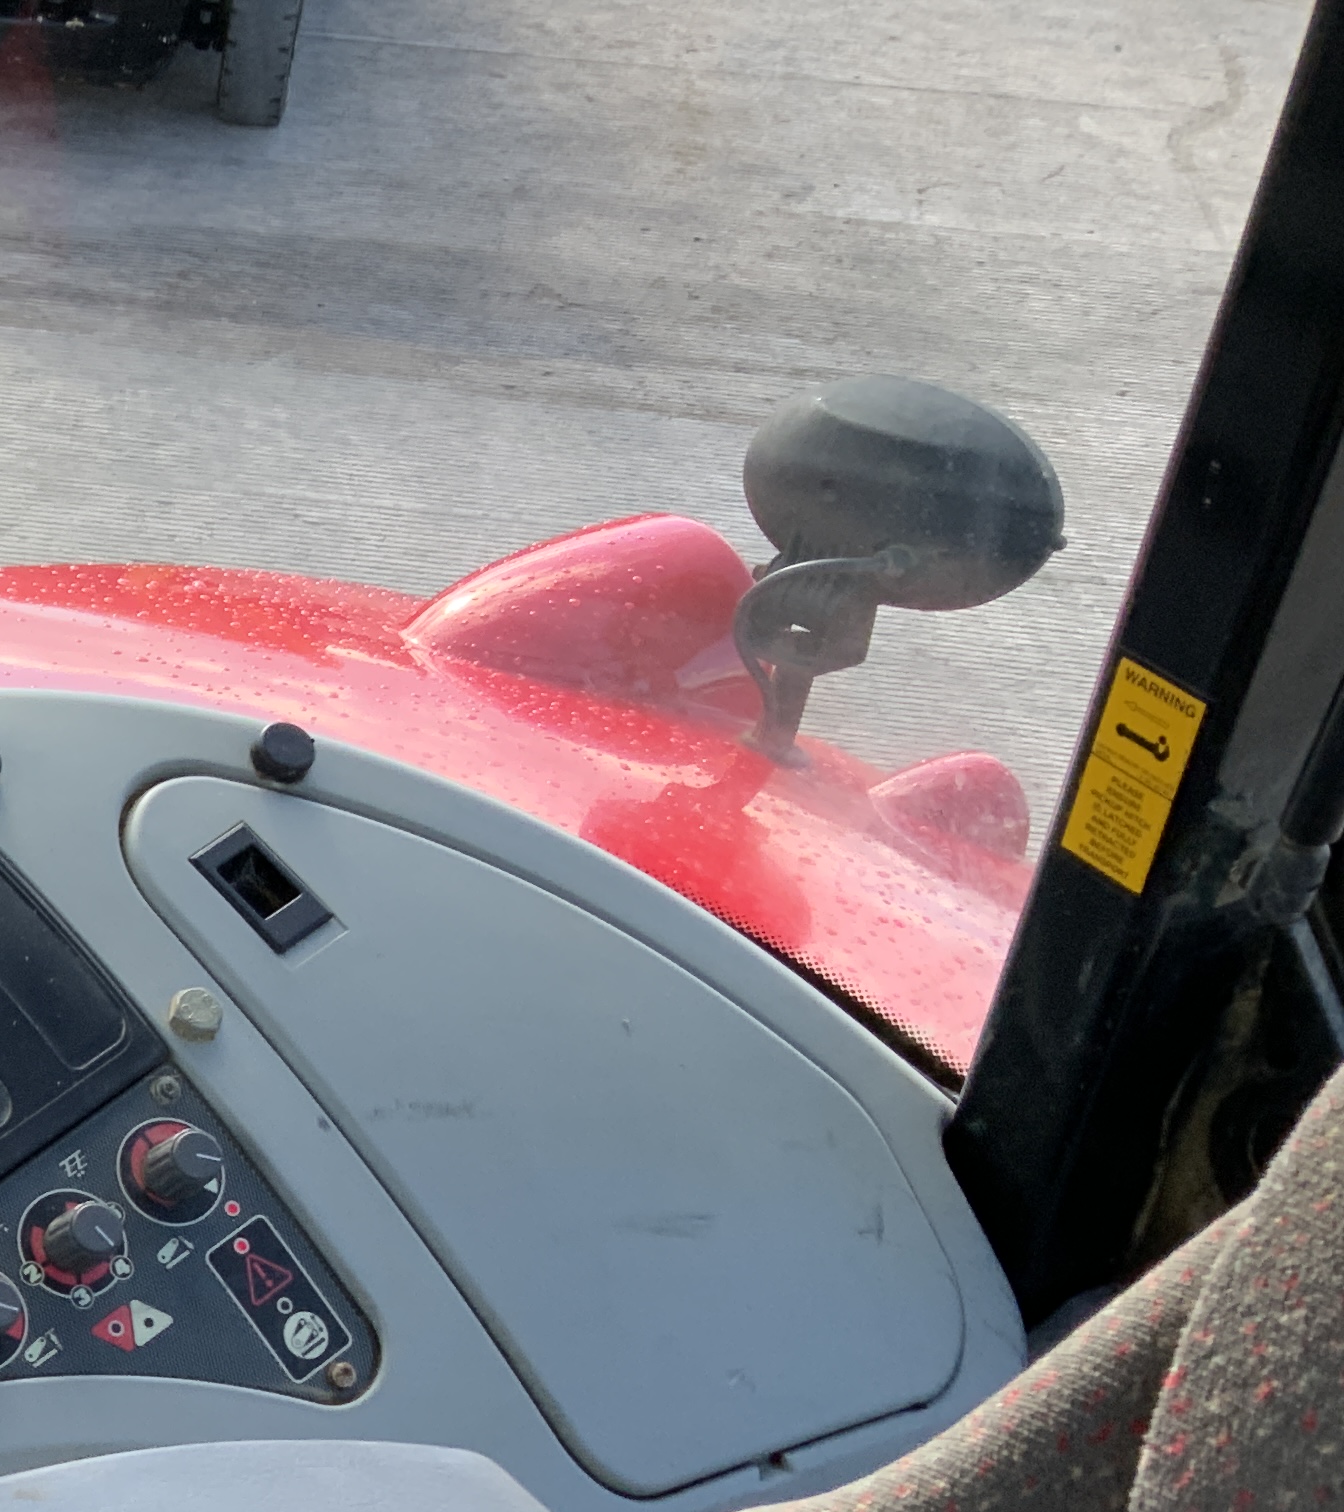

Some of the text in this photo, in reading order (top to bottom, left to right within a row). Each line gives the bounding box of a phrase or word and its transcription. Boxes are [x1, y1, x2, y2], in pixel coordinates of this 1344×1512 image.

[1124, 666, 1196, 719] WARNING
[23, 1264, 42, 1283] 2
[74, 1288, 91, 1306] 3
